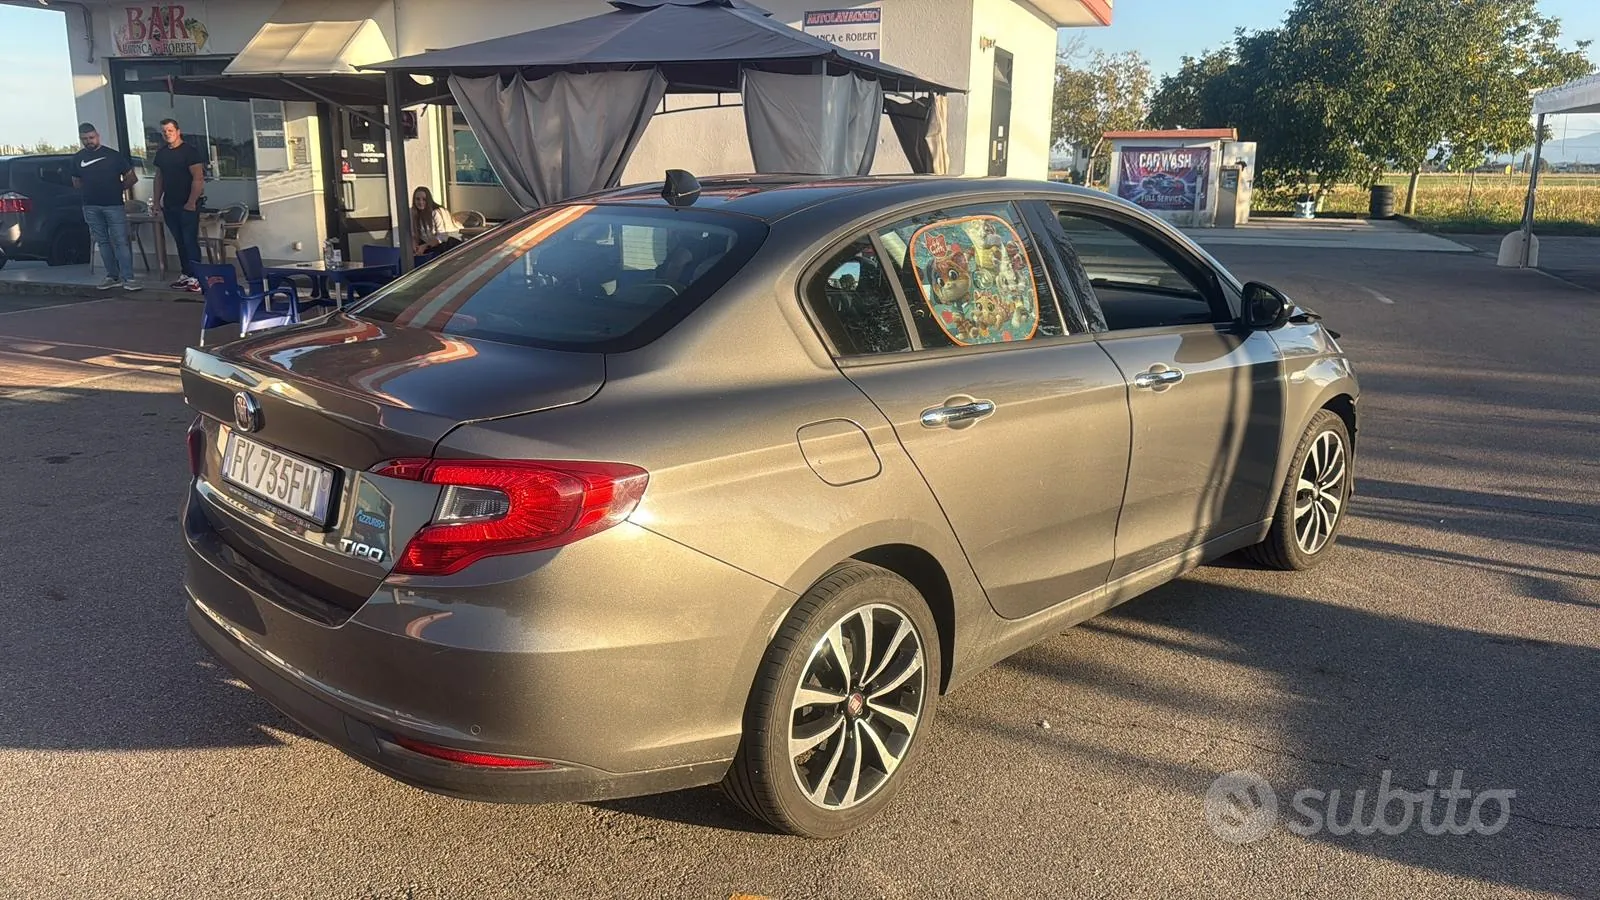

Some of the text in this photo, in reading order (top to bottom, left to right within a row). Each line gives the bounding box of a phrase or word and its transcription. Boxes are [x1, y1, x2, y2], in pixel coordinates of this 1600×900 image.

[125, 5, 189, 41] BAR
[807, 10, 880, 24] AUTOLAVAGGIO
[846, 32, 877, 42] ROBERT
[163, 42, 197, 54] ROBERT
[1139, 153, 1192, 171] CAR WASH
[340, 538, 384, 563] TIPO
